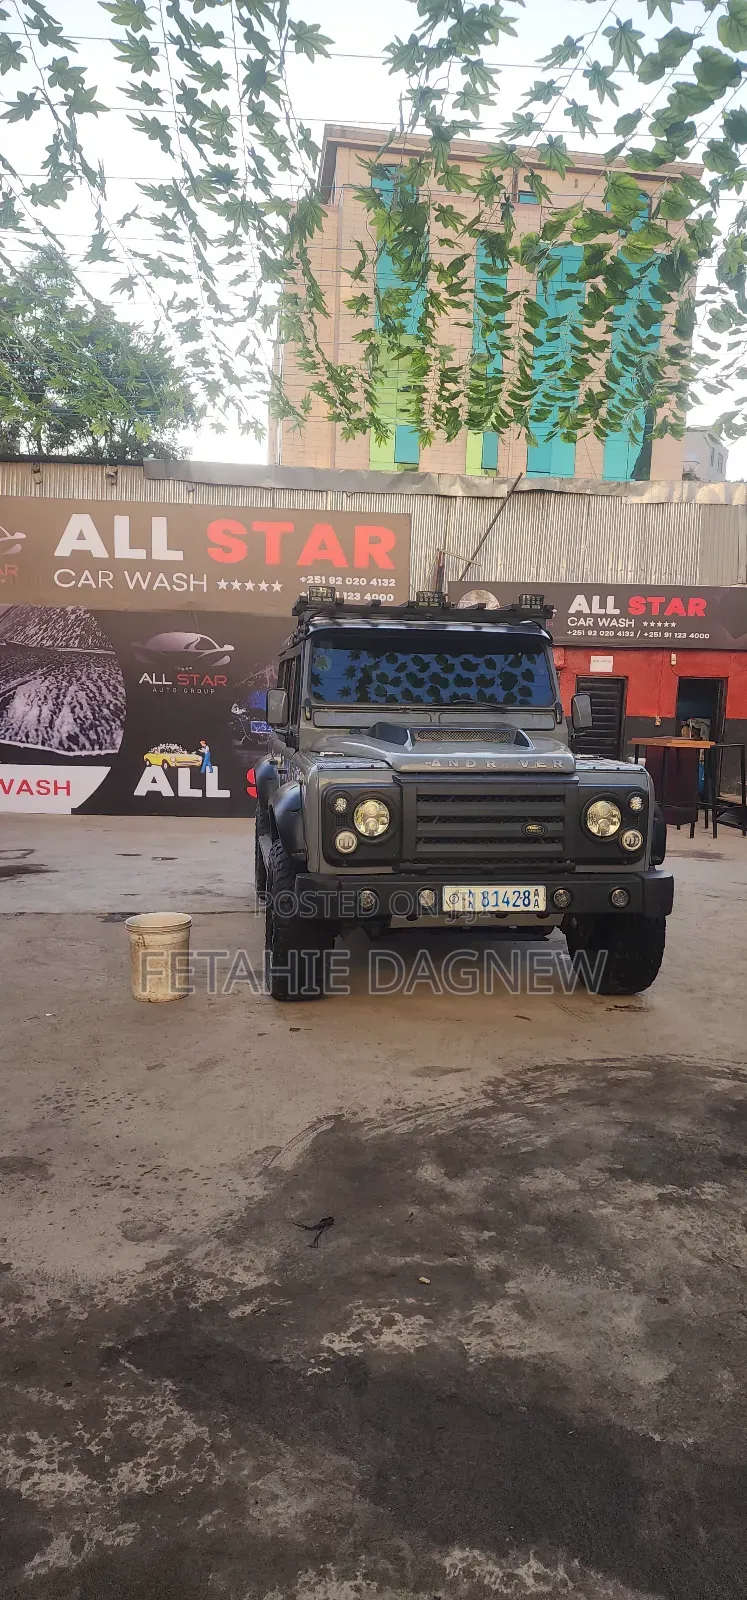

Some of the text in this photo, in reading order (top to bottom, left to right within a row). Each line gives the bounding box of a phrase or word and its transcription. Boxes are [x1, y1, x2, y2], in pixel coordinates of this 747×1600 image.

[53, 513, 397, 570] ALL STAR
[53, 568, 207, 592] CAR WASH
[300, 575, 396, 587] +251 92 020 4132
[568, 594, 707, 617] ALL STAR
[567, 616, 594, 628] CAR
[598, 617, 635, 629] WASH
[643, 631, 662, 639] +251
[139, 672, 228, 687] ALL STAR
[486, 759, 563, 768] RVER
[133, 765, 231, 798] ALL
[481, 889, 531, 908] 81428
